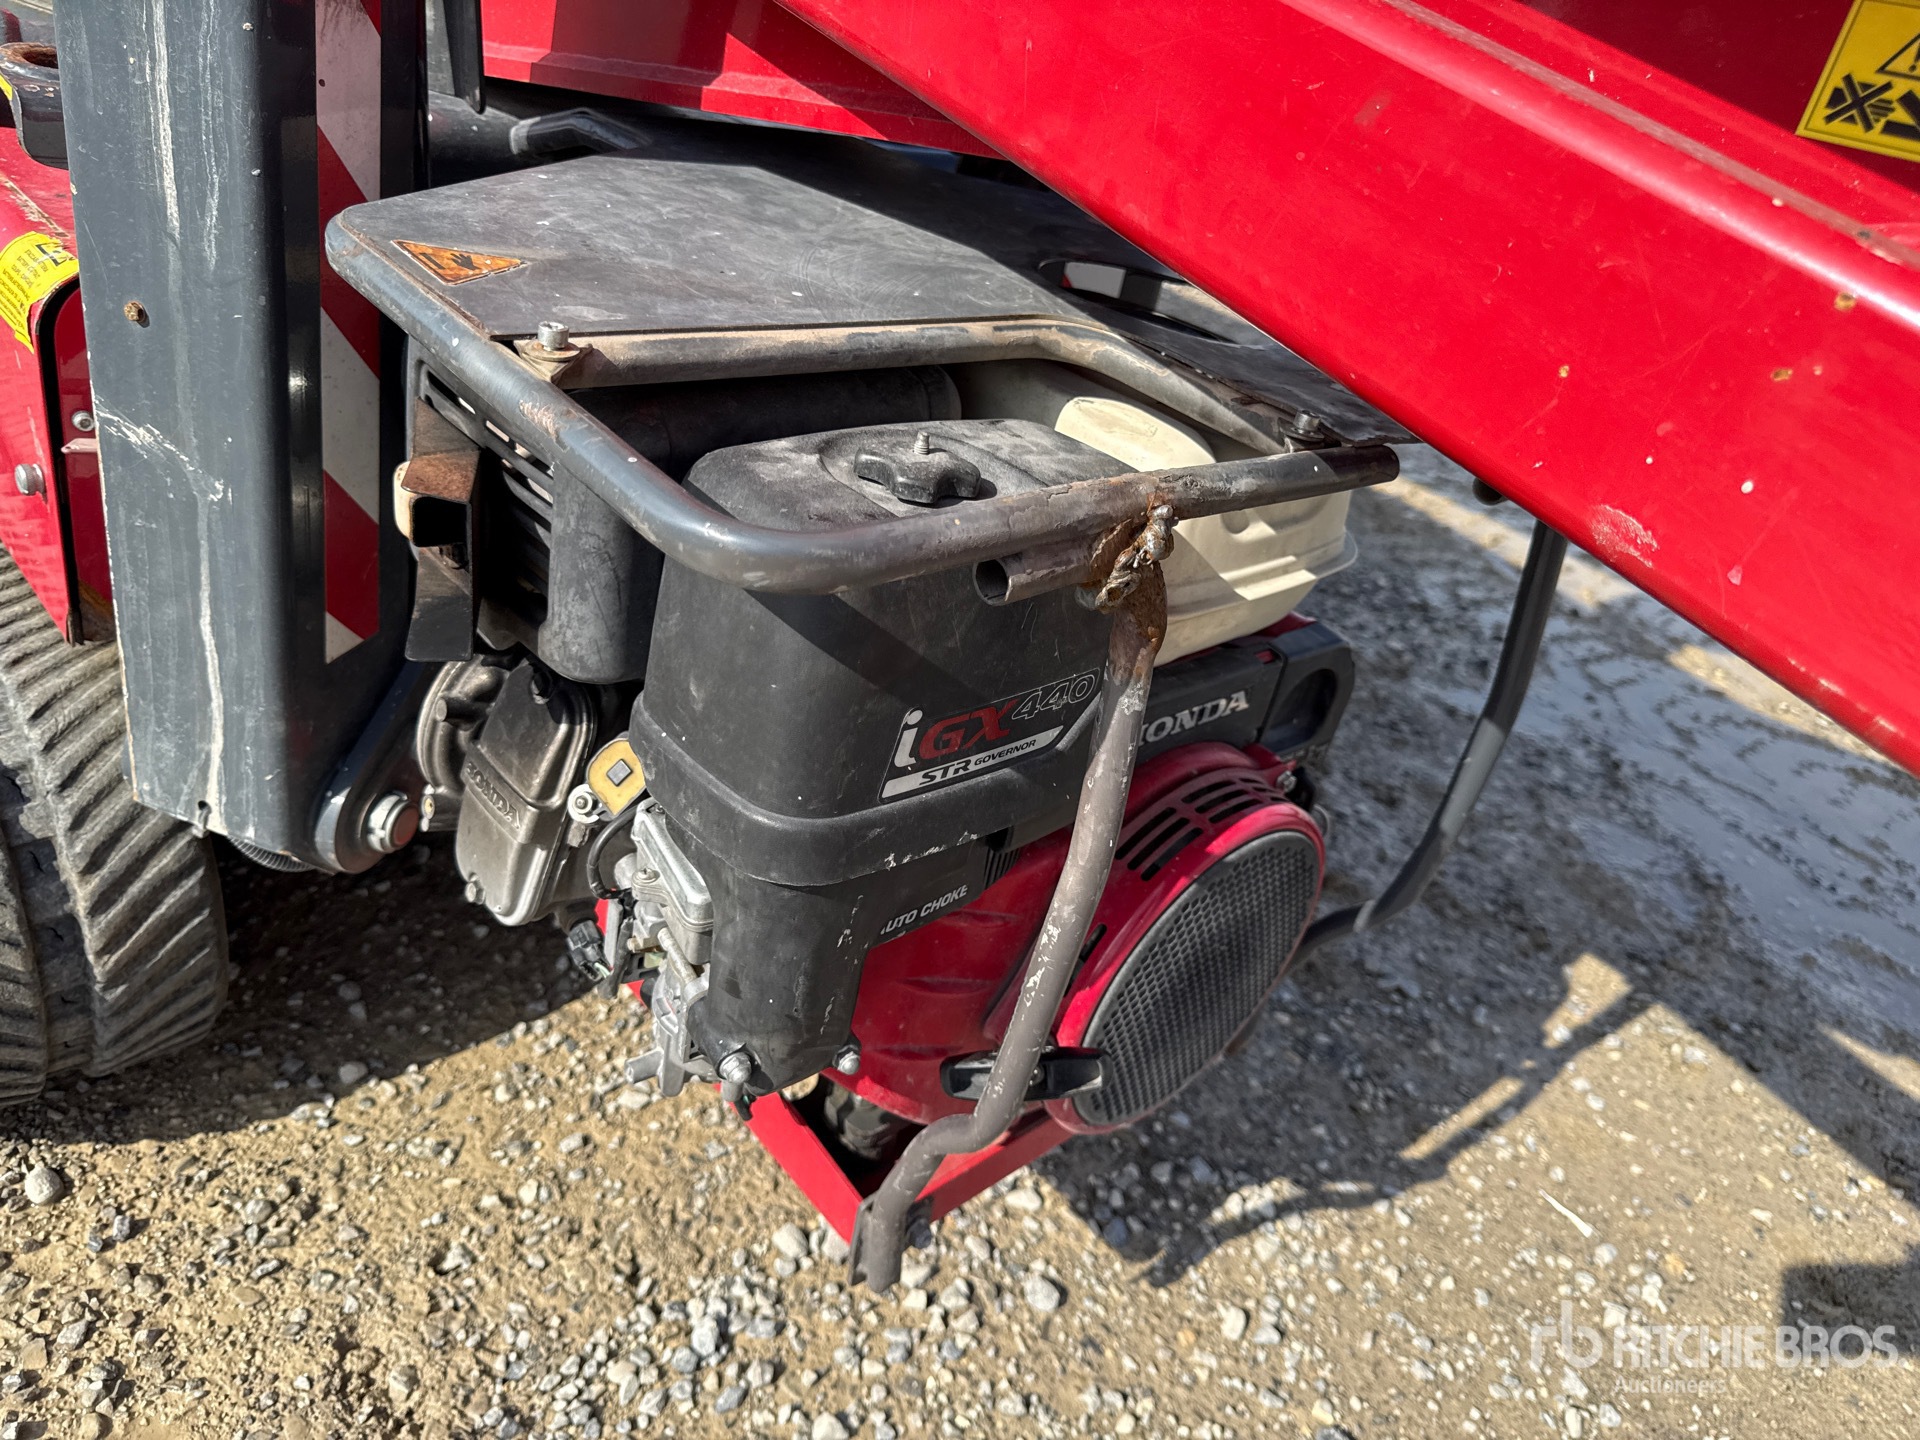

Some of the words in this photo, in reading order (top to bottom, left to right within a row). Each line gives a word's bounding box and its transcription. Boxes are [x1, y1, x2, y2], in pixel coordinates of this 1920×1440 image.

[919, 760, 972, 786] STR
[974, 739, 1037, 767] GOVERNOR
[920, 884, 968, 917] CHOKE
